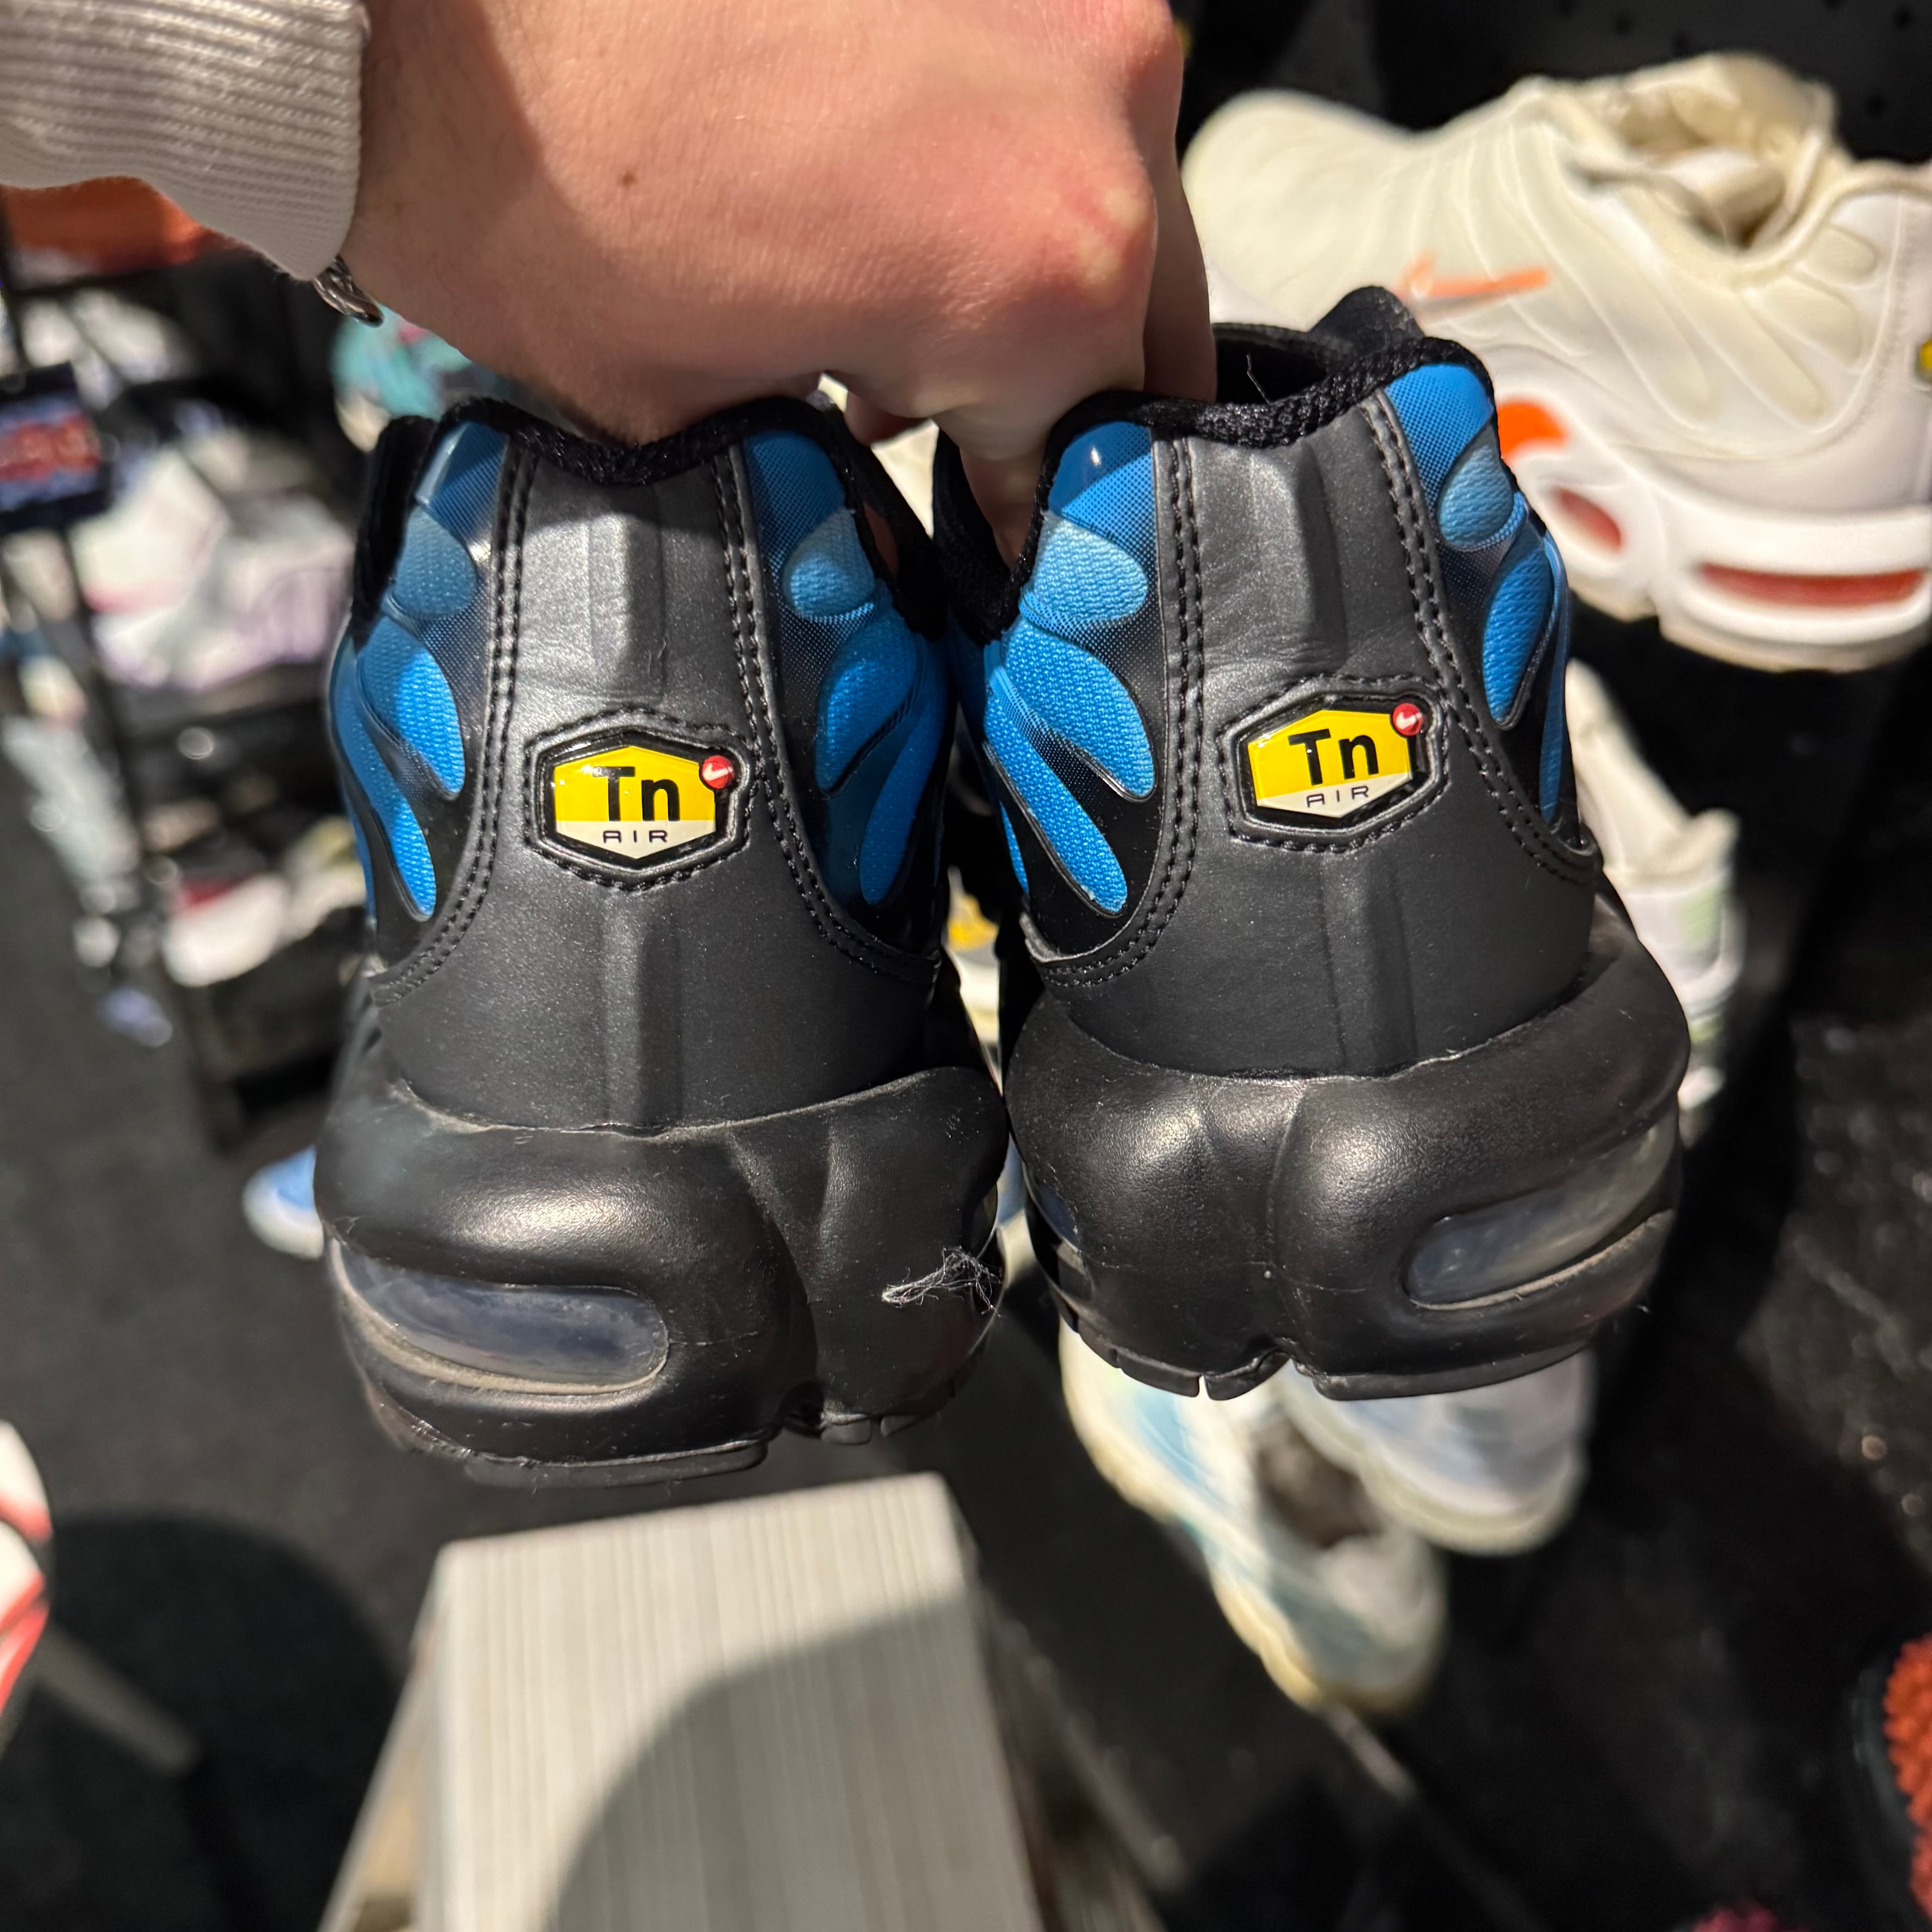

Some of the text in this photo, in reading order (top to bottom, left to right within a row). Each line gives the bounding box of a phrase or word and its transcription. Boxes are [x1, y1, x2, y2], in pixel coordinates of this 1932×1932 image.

[1287, 729, 1379, 786] Tn
[592, 766, 680, 822] Tn
[1306, 785, 1369, 808] AIR
[603, 830, 668, 843] AIR
